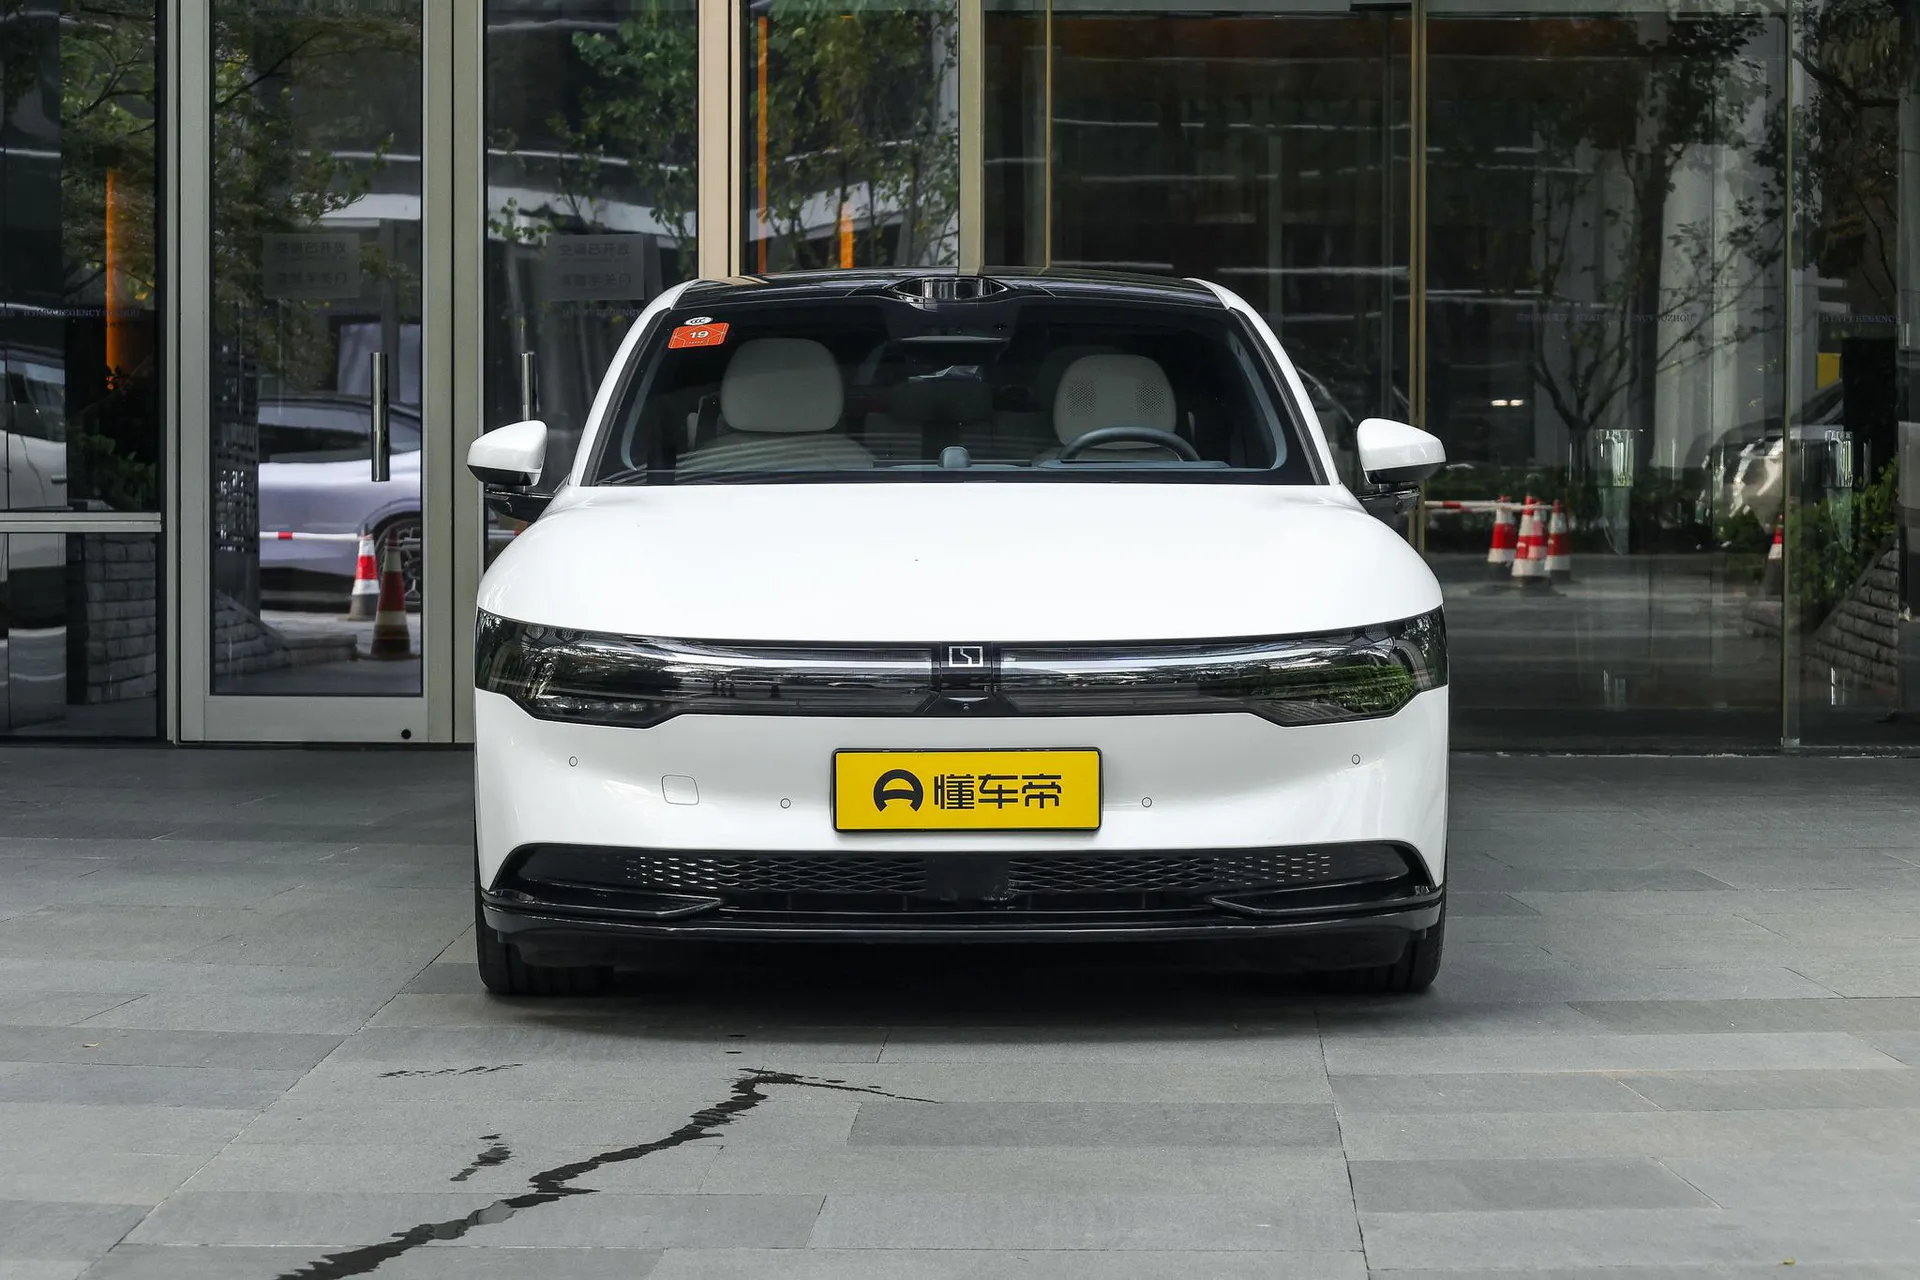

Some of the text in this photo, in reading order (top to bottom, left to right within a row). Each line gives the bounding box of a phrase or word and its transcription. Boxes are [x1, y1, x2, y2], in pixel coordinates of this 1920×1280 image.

[690, 330, 709, 339] 19
[934, 773, 1062, 809] 懂车帝
